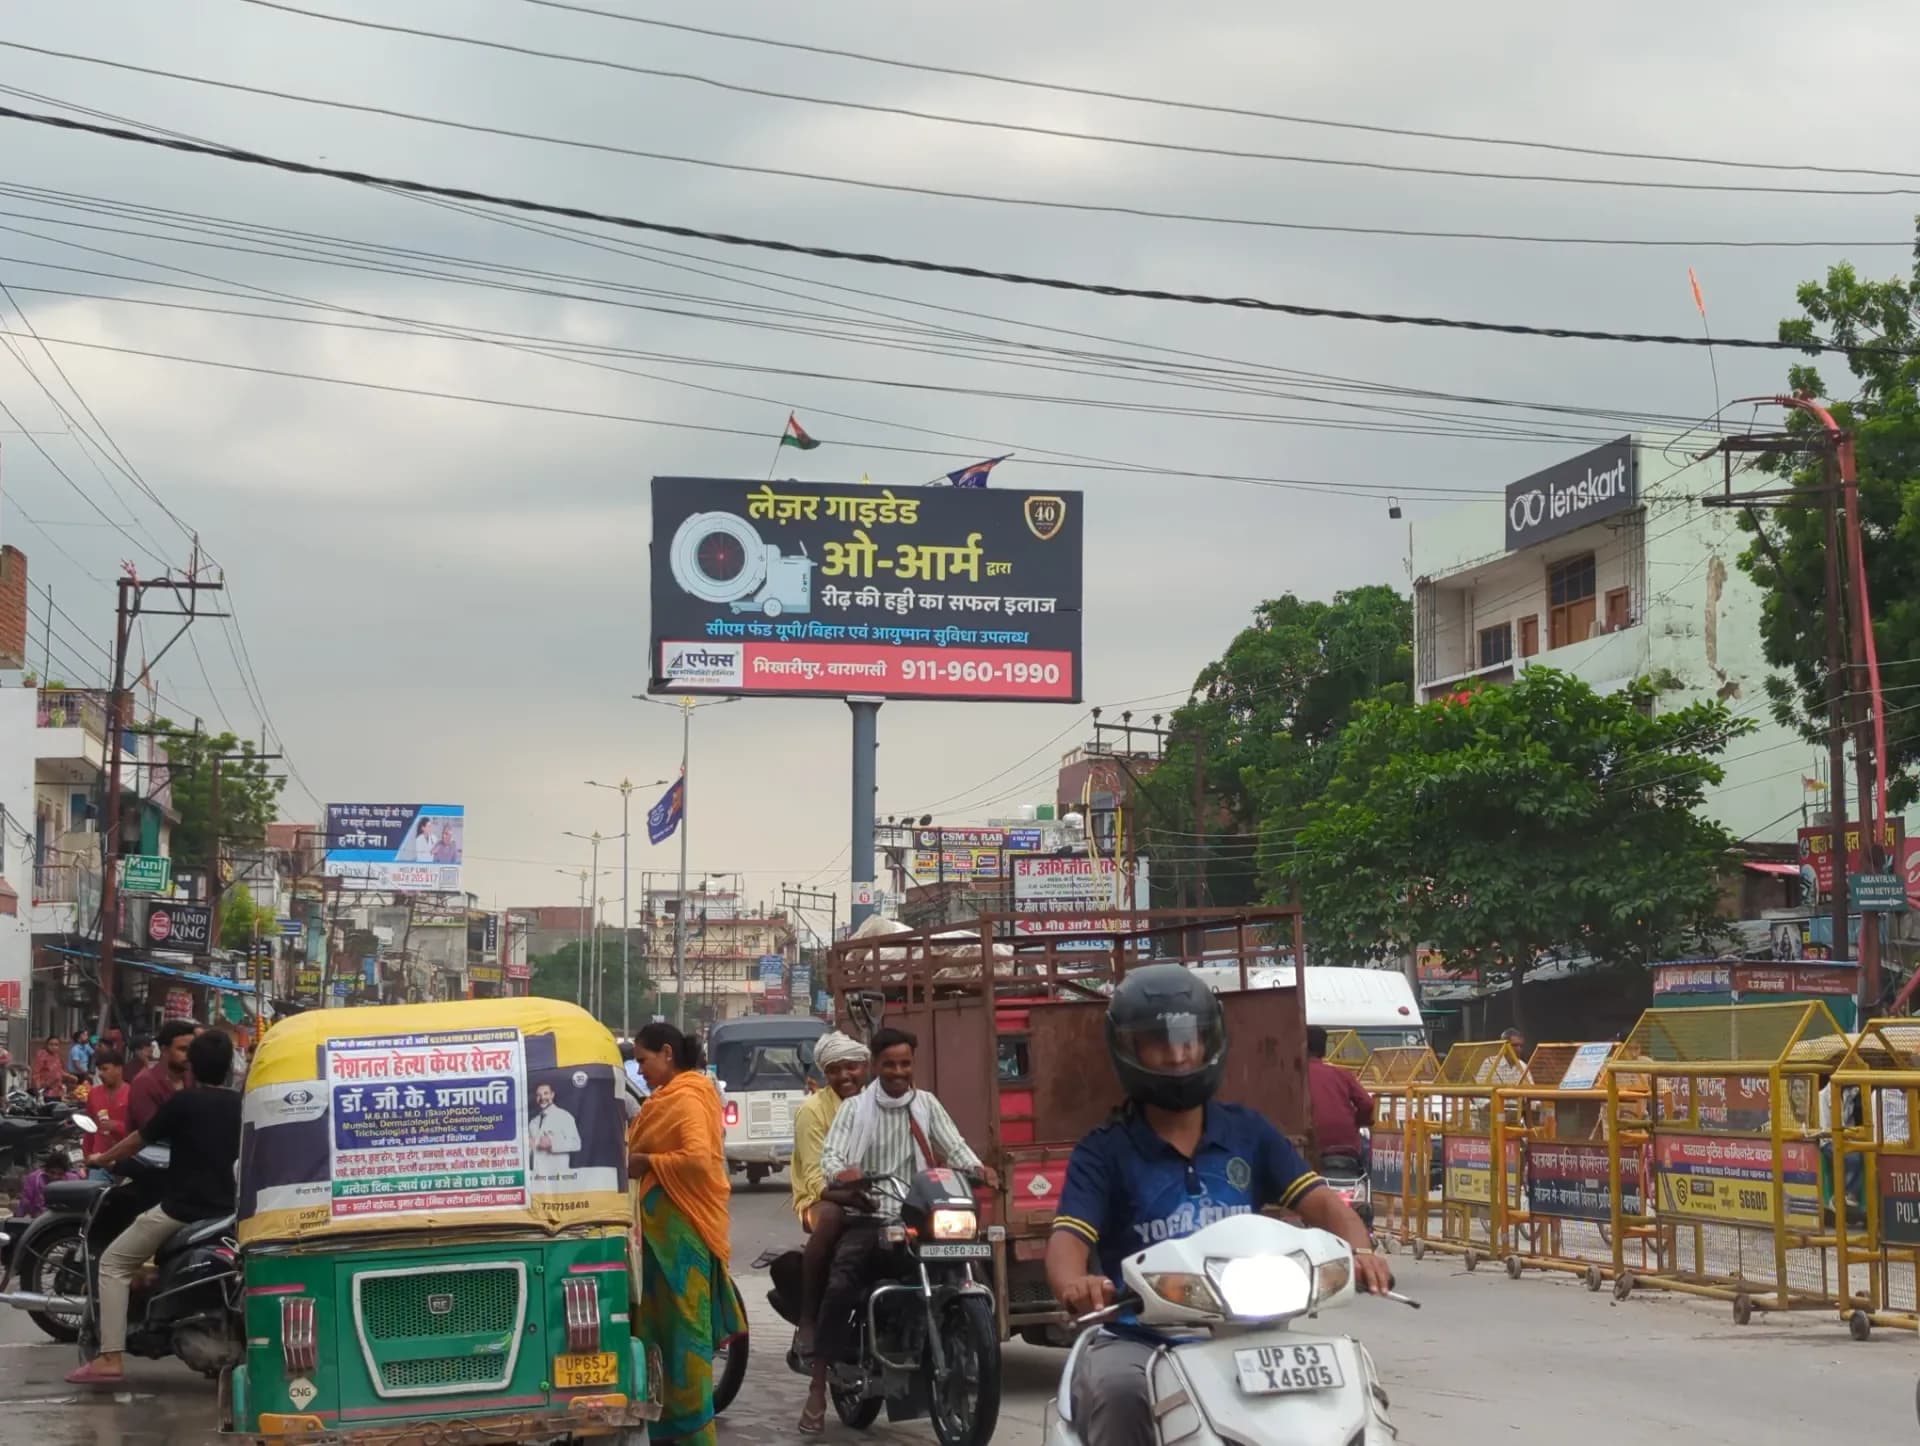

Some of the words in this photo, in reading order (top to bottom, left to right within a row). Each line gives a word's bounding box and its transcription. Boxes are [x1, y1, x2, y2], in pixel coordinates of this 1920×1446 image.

[1550, 458, 1626, 520] lenskart
[747, 484, 820, 525] लेज़र
[823, 489, 921, 529] गाइडेड
[1034, 506, 1055, 521] 40
[821, 529, 983, 582] ओ-आर्म
[986, 561, 1012, 576] द्वारा
[821, 585, 851, 611] रीढ़
[855, 585, 881, 608] की
[884, 587, 915, 614] हड्डी
[918, 593, 943, 610] का
[948, 594, 1000, 612] सफल
[1004, 597, 1057, 616] इलाज
[705, 618, 745, 636] सीएम
[748, 621, 773, 636] फंड
[848, 623, 868, 639] एवं
[871, 627, 930, 645] आयुष्मान
[933, 625, 977, 646] सुविधा
[980, 630, 1030, 644] उपलब्ध
[685, 649, 735, 668] एपेक्स
[753, 657, 825, 680] भिखारीपुर,
[827, 660, 888, 677] वाराणसी
[901, 659, 1060, 685] 911-960-1990
[172, 911, 206, 925] HANDI
[170, 923, 206, 940] KING
[333, 1053, 388, 1078] नेशनल
[430, 1047, 467, 1073] केयर
[471, 1045, 512, 1070] सेन्टर
[435, 1080, 510, 1108] प्रजापति
[1134, 1211, 1194, 1244] YOGA
[1258, 1348, 1284, 1368] UP
[1293, 1345, 1320, 1366] 63
[1264, 1365, 1333, 1389] X4505
[289, 1384, 312, 1398] CNG
